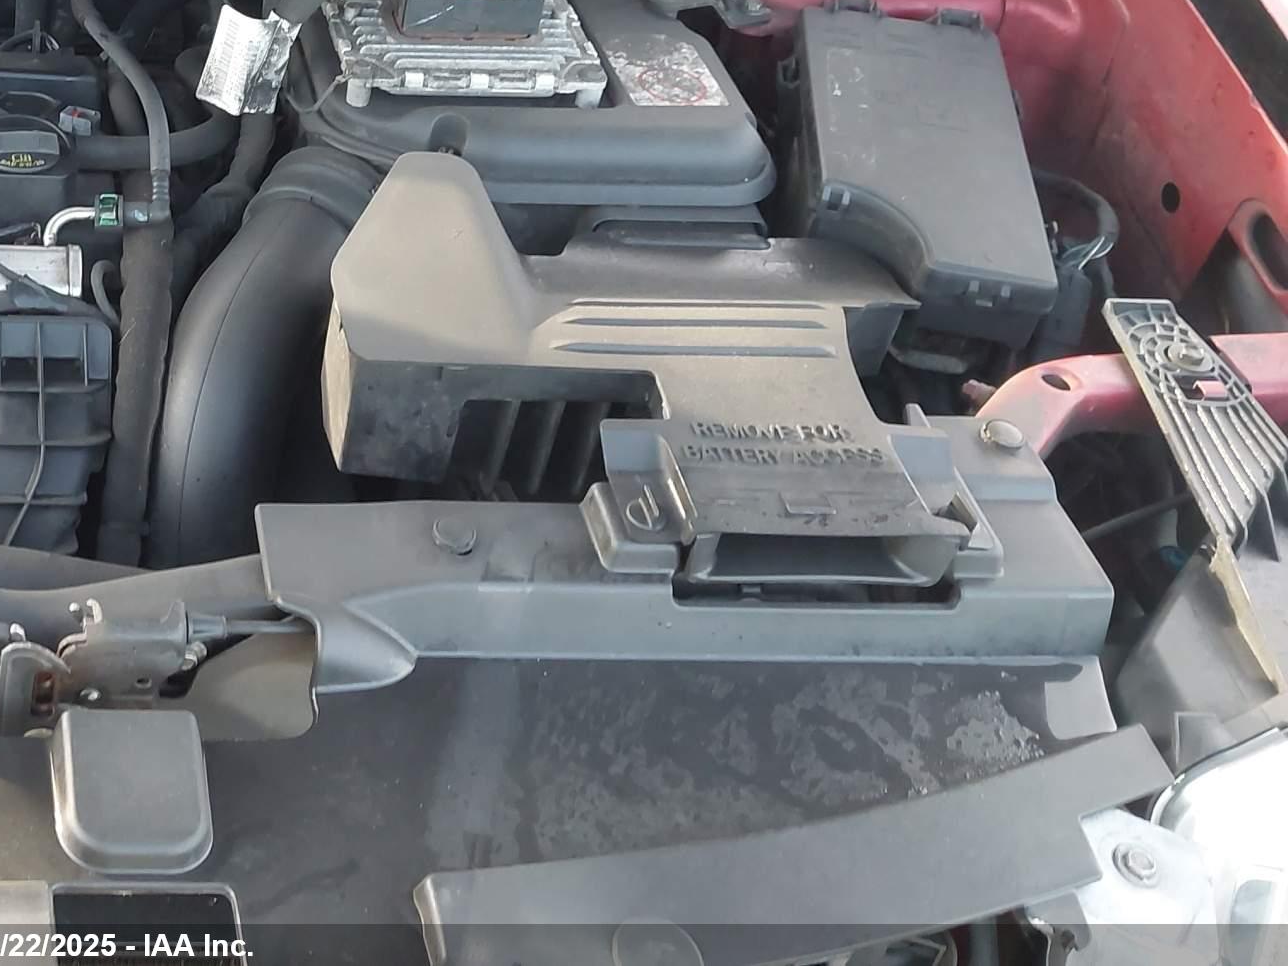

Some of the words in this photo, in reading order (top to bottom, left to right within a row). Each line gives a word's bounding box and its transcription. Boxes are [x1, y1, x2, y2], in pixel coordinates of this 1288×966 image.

[691, 422, 792, 441] REMOVE
[795, 423, 847, 442] FOR
[682, 445, 782, 465] BATTERY
[792, 447, 886, 466] ACCESS
